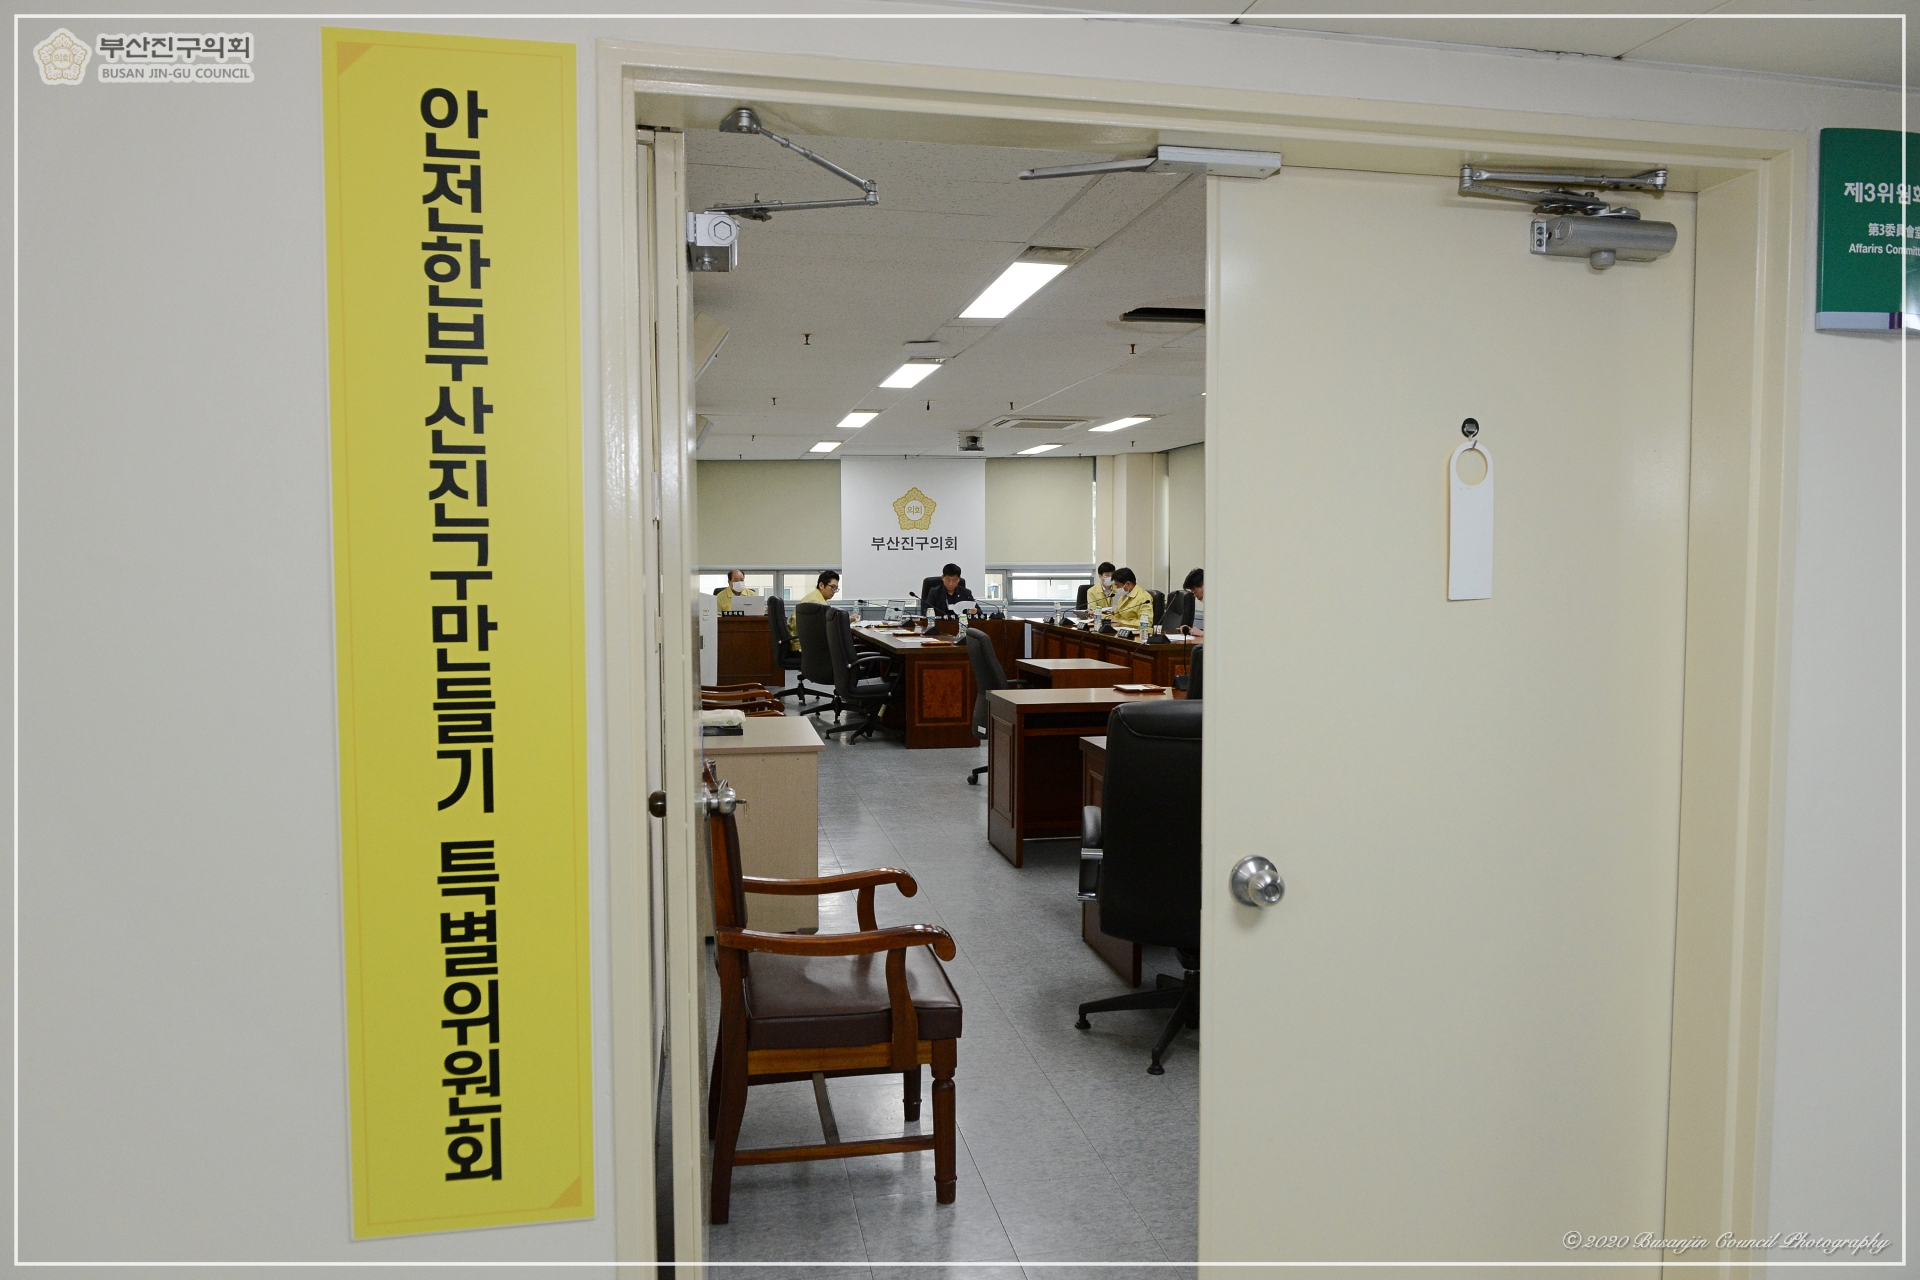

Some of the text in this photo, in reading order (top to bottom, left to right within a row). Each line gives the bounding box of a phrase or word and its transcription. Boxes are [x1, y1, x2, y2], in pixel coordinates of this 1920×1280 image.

[1849, 243, 1883, 254] Affarirs
[871, 536, 957, 551] 부산진구의회
[420, 87, 503, 1182] 안전한부산진구만들기 특별위원회
